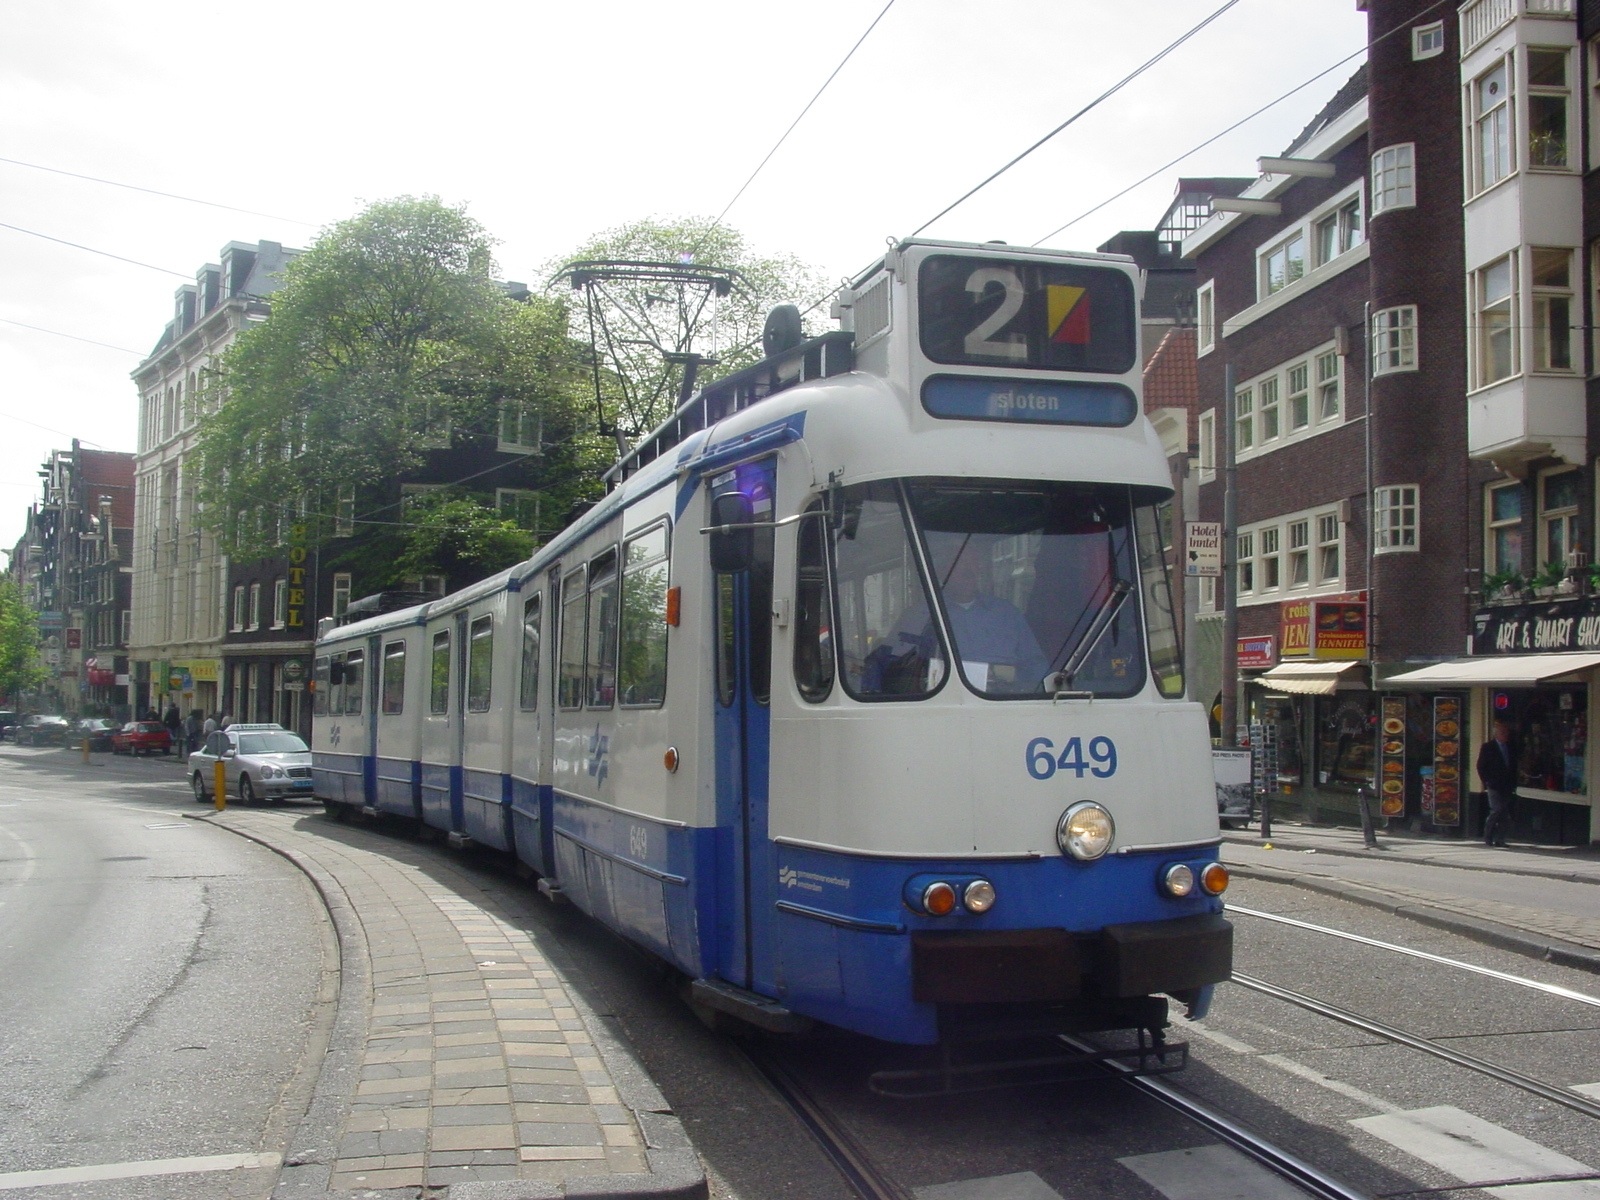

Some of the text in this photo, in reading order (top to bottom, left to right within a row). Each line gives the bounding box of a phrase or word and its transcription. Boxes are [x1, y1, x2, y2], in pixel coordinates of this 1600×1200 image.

[964, 267, 1028, 358] 2
[997, 390, 1059, 410] sloten
[1189, 537, 1218, 548] Inntel
[1191, 525, 1218, 536] Hotel
[1317, 639, 1366, 649] JENNIFER
[1496, 622, 1519, 649] ART
[1522, 621, 1531, 648] &
[1534, 618, 1574, 648] SMART
[1025, 736, 1118, 780] 649
[630, 825, 647, 859] 649
